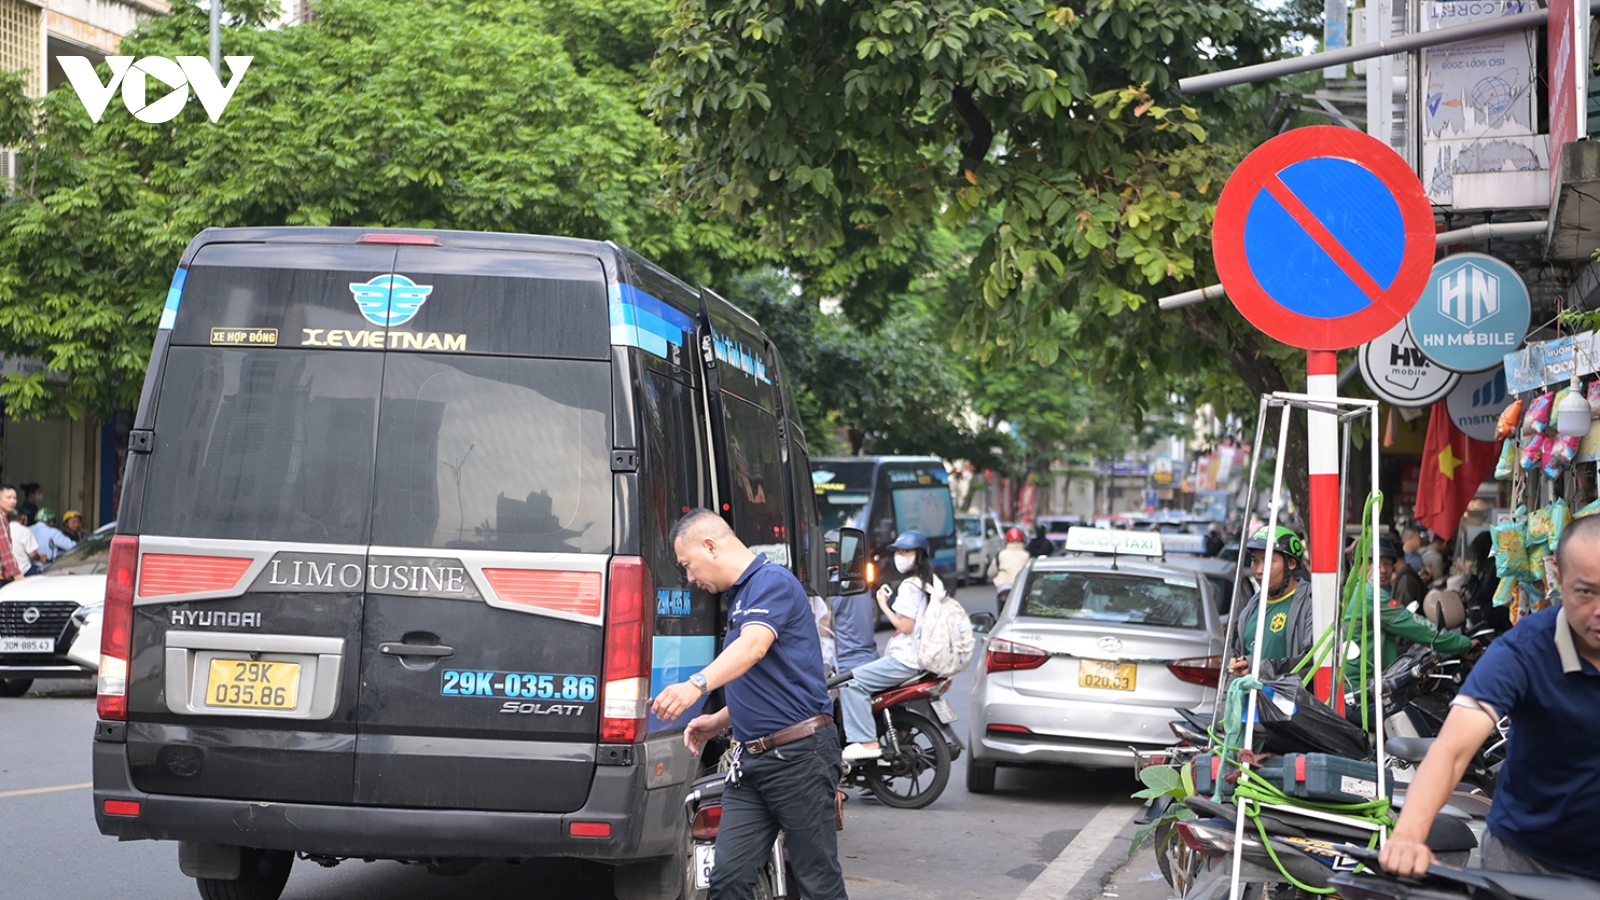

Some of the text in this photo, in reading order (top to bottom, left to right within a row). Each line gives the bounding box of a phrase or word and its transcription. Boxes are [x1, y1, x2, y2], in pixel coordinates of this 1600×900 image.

[1489, 58, 1505, 67] ISO
[213, 331, 226, 342] XE
[227, 331, 248, 344] HỢP
[1423, 333, 1445, 347] HN
[1391, 368, 1427, 377] mobile
[1459, 413, 1501, 427] msmo
[1124, 537, 1154, 550] TAXI
[269, 559, 465, 593] LIMOUSINE
[171, 609, 262, 628] HYUNDAI
[234, 662, 274, 683] 29K
[442, 670, 596, 701] 29K-035.86
[215, 683, 287, 706] 035.86
[500, 701, 585, 717] SOLATI
